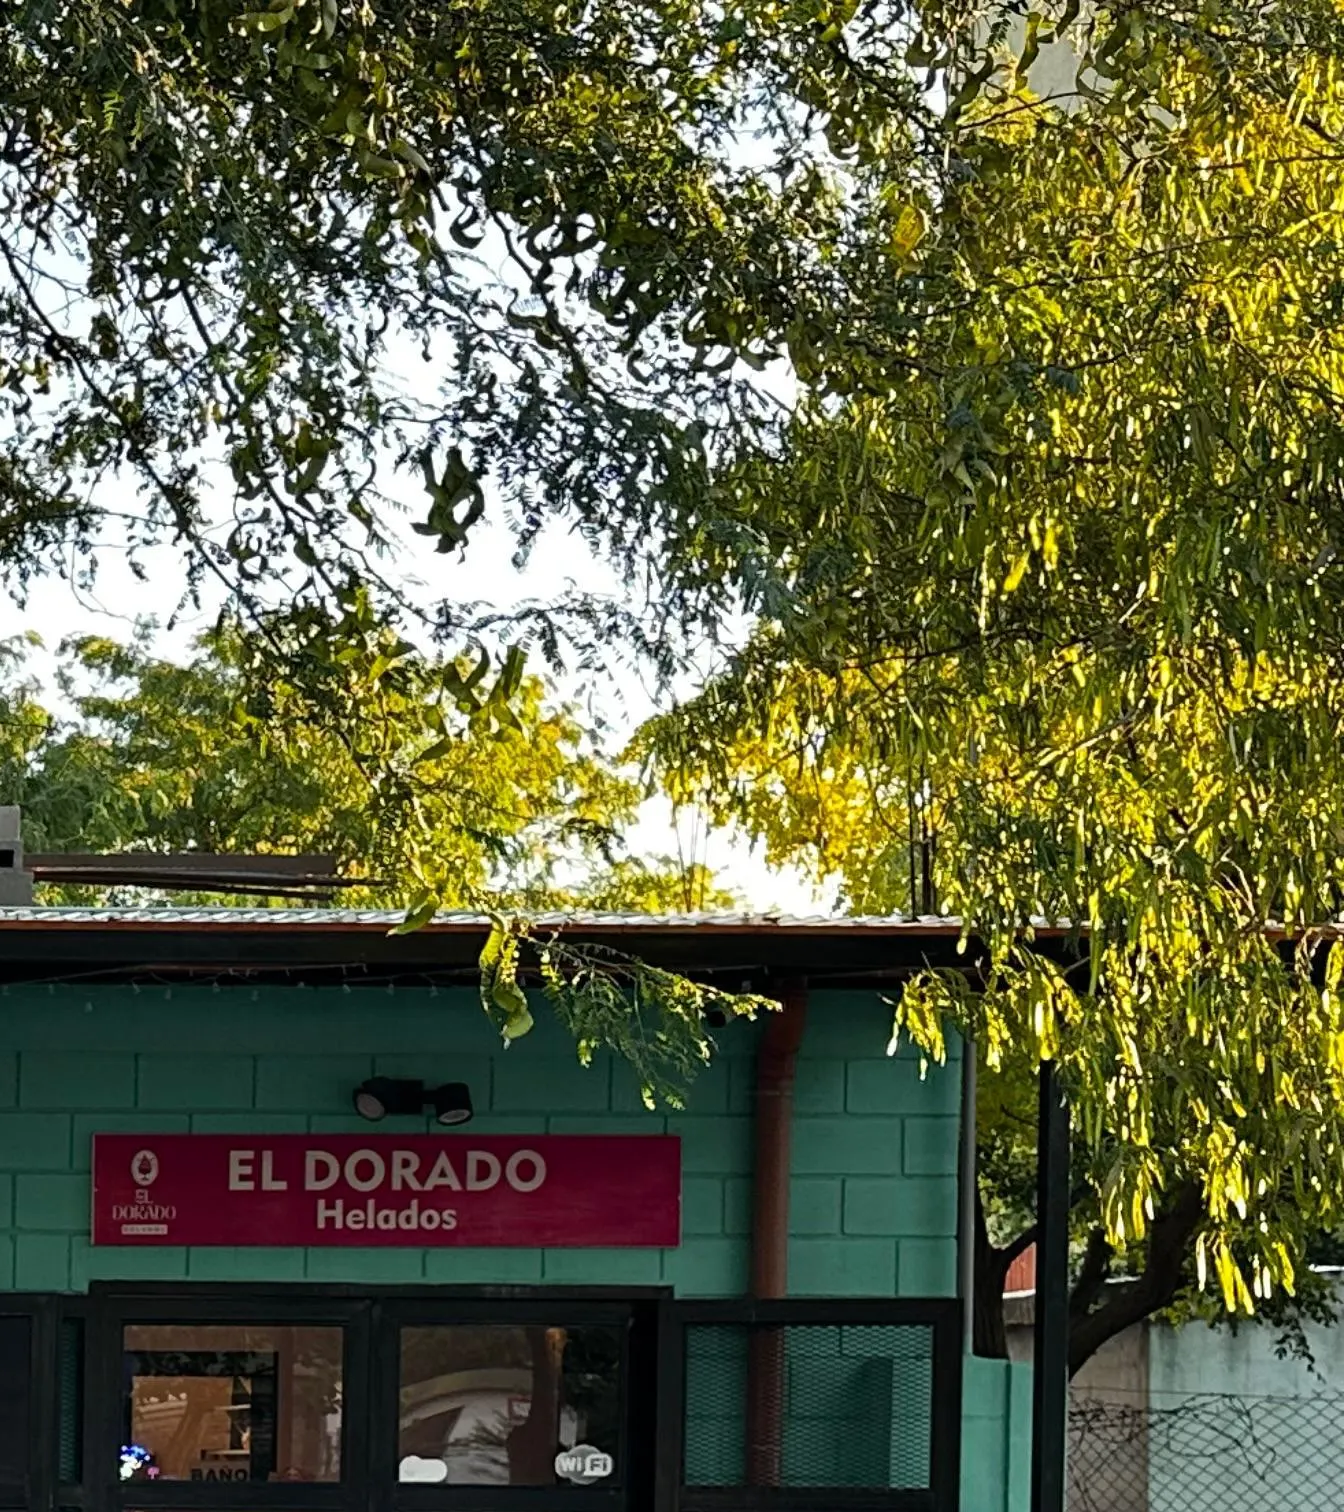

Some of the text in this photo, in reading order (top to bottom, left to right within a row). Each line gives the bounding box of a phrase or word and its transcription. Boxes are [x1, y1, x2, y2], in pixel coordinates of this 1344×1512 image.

[228, 1149, 547, 1192] EL DORADO
[316, 1199, 457, 1230] Helados
